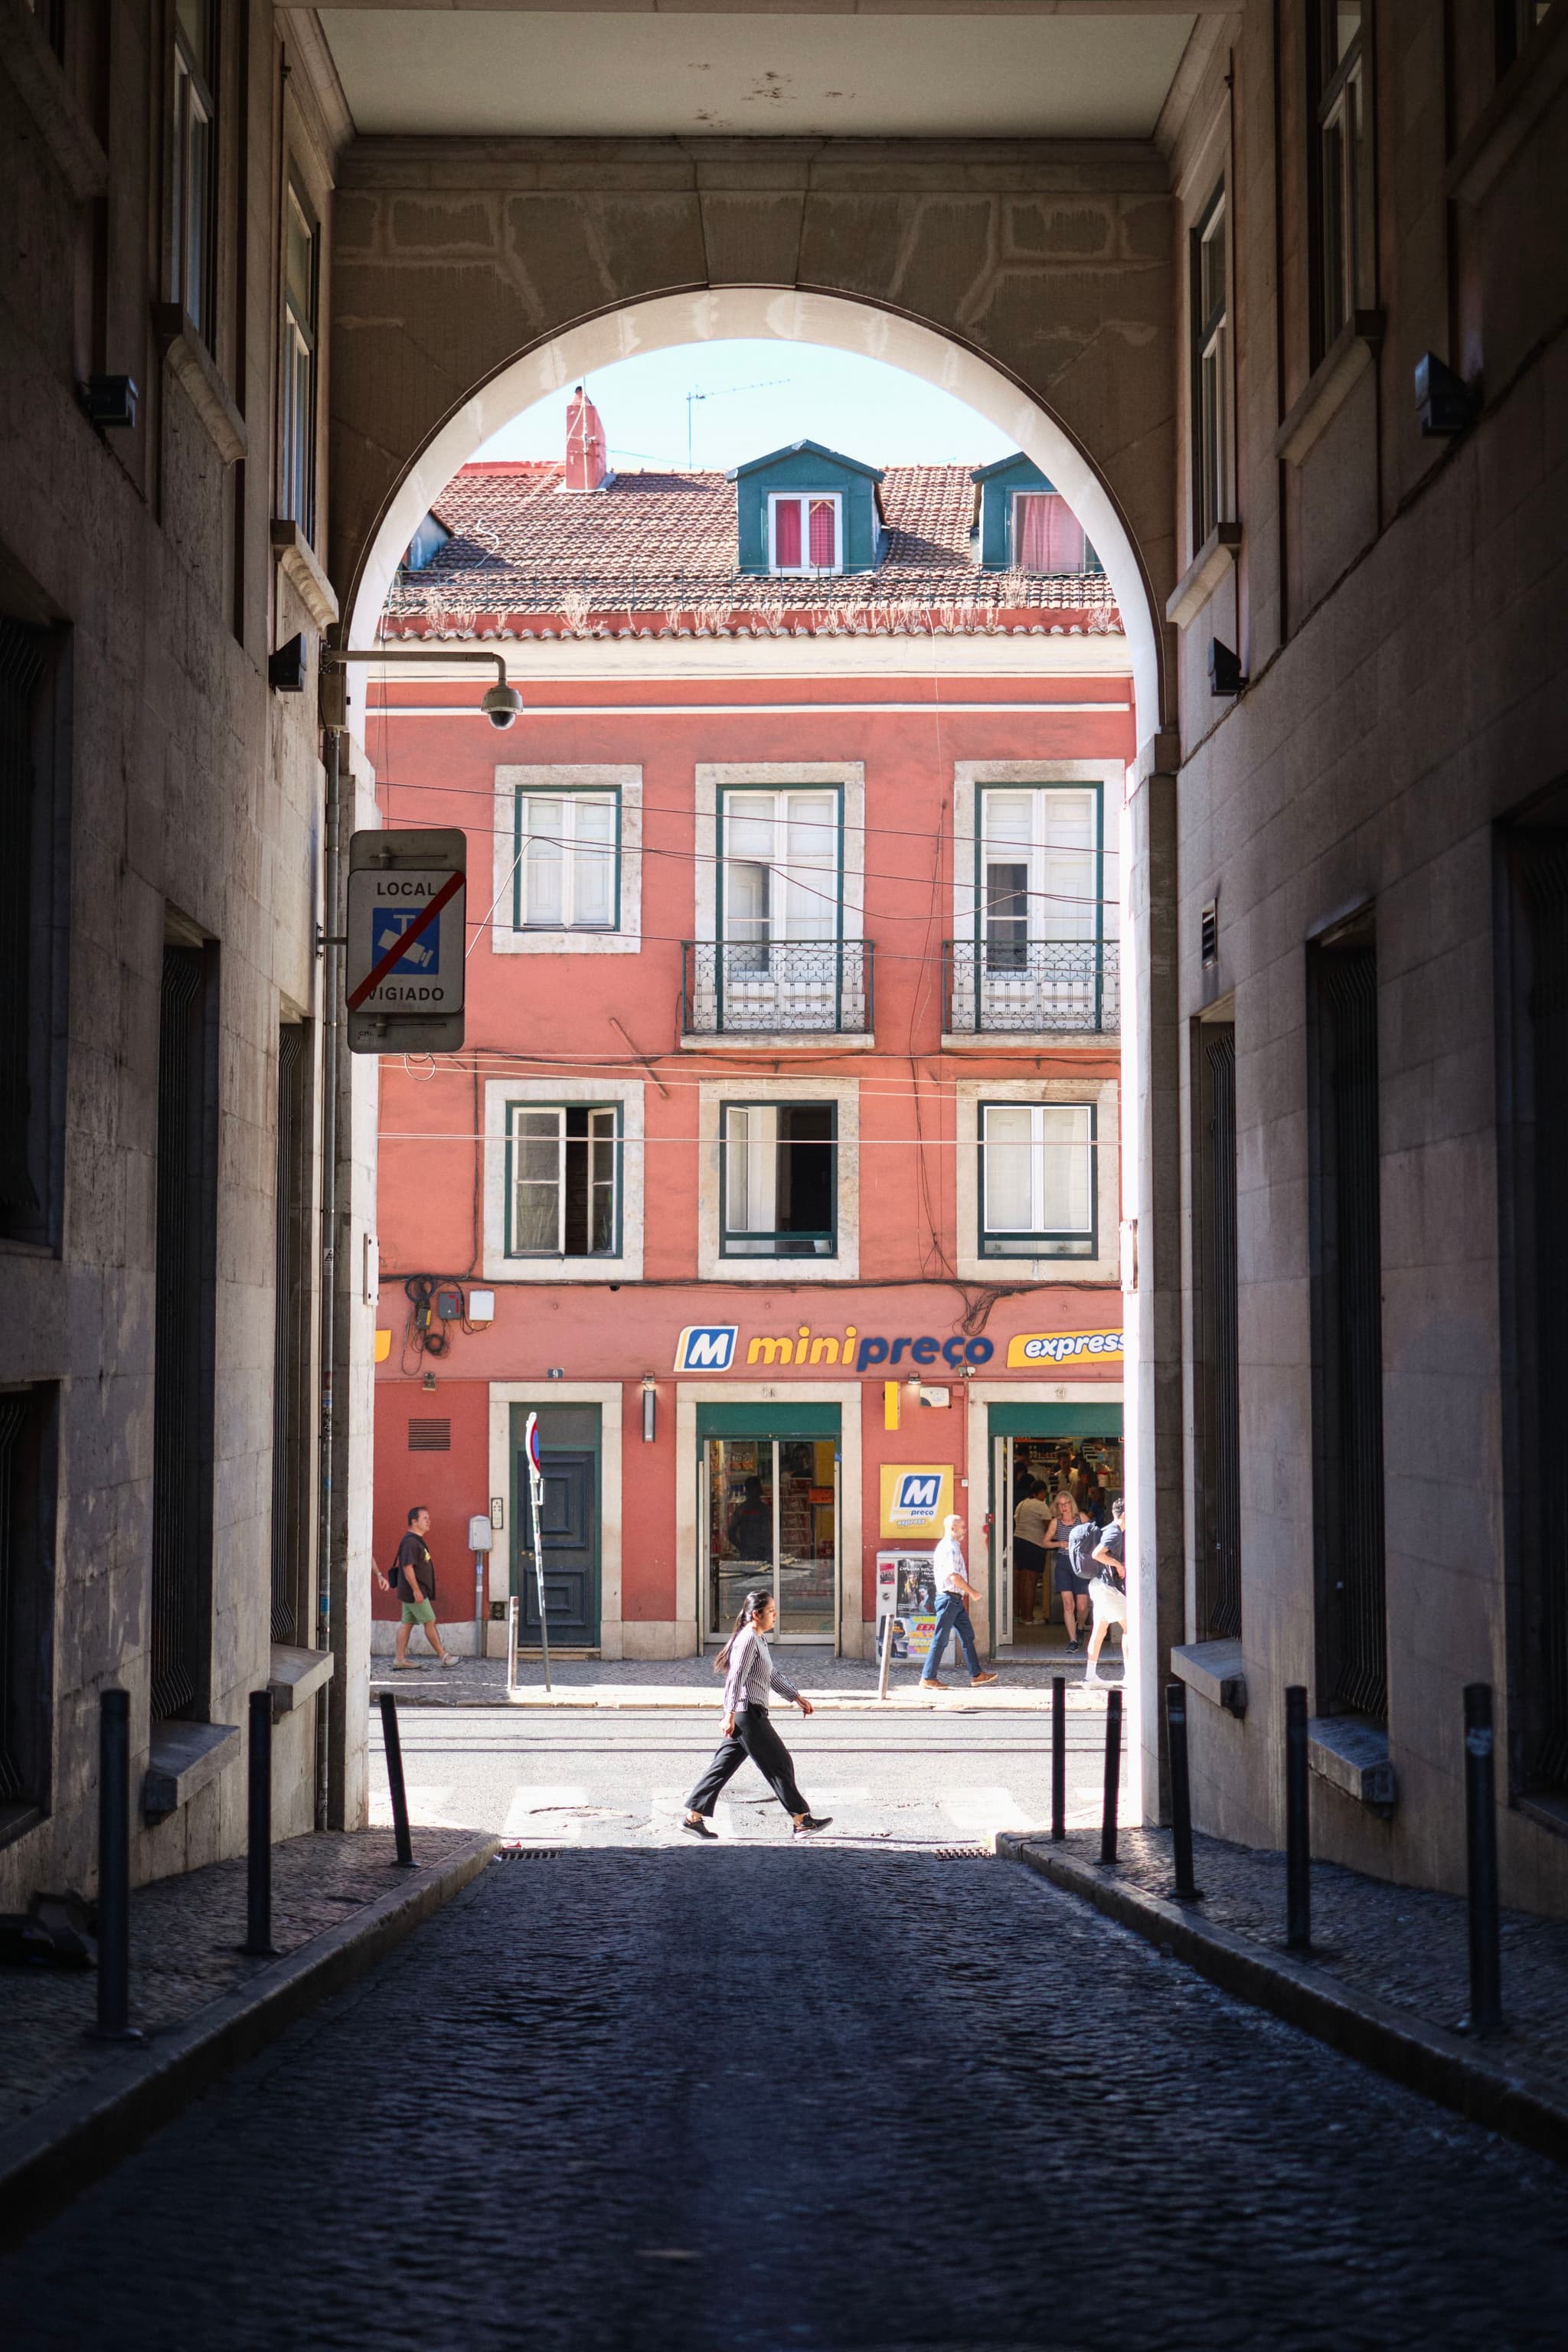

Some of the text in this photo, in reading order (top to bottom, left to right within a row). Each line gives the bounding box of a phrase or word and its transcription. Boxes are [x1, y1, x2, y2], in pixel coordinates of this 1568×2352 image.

[377, 882, 436, 895] LOCAL
[368, 987, 444, 1001] VIGIADO
[688, 1333, 730, 1366] M
[747, 1326, 994, 1372] minipreço
[553, 1369, 559, 1378] 9
[903, 1478, 936, 1505] M
